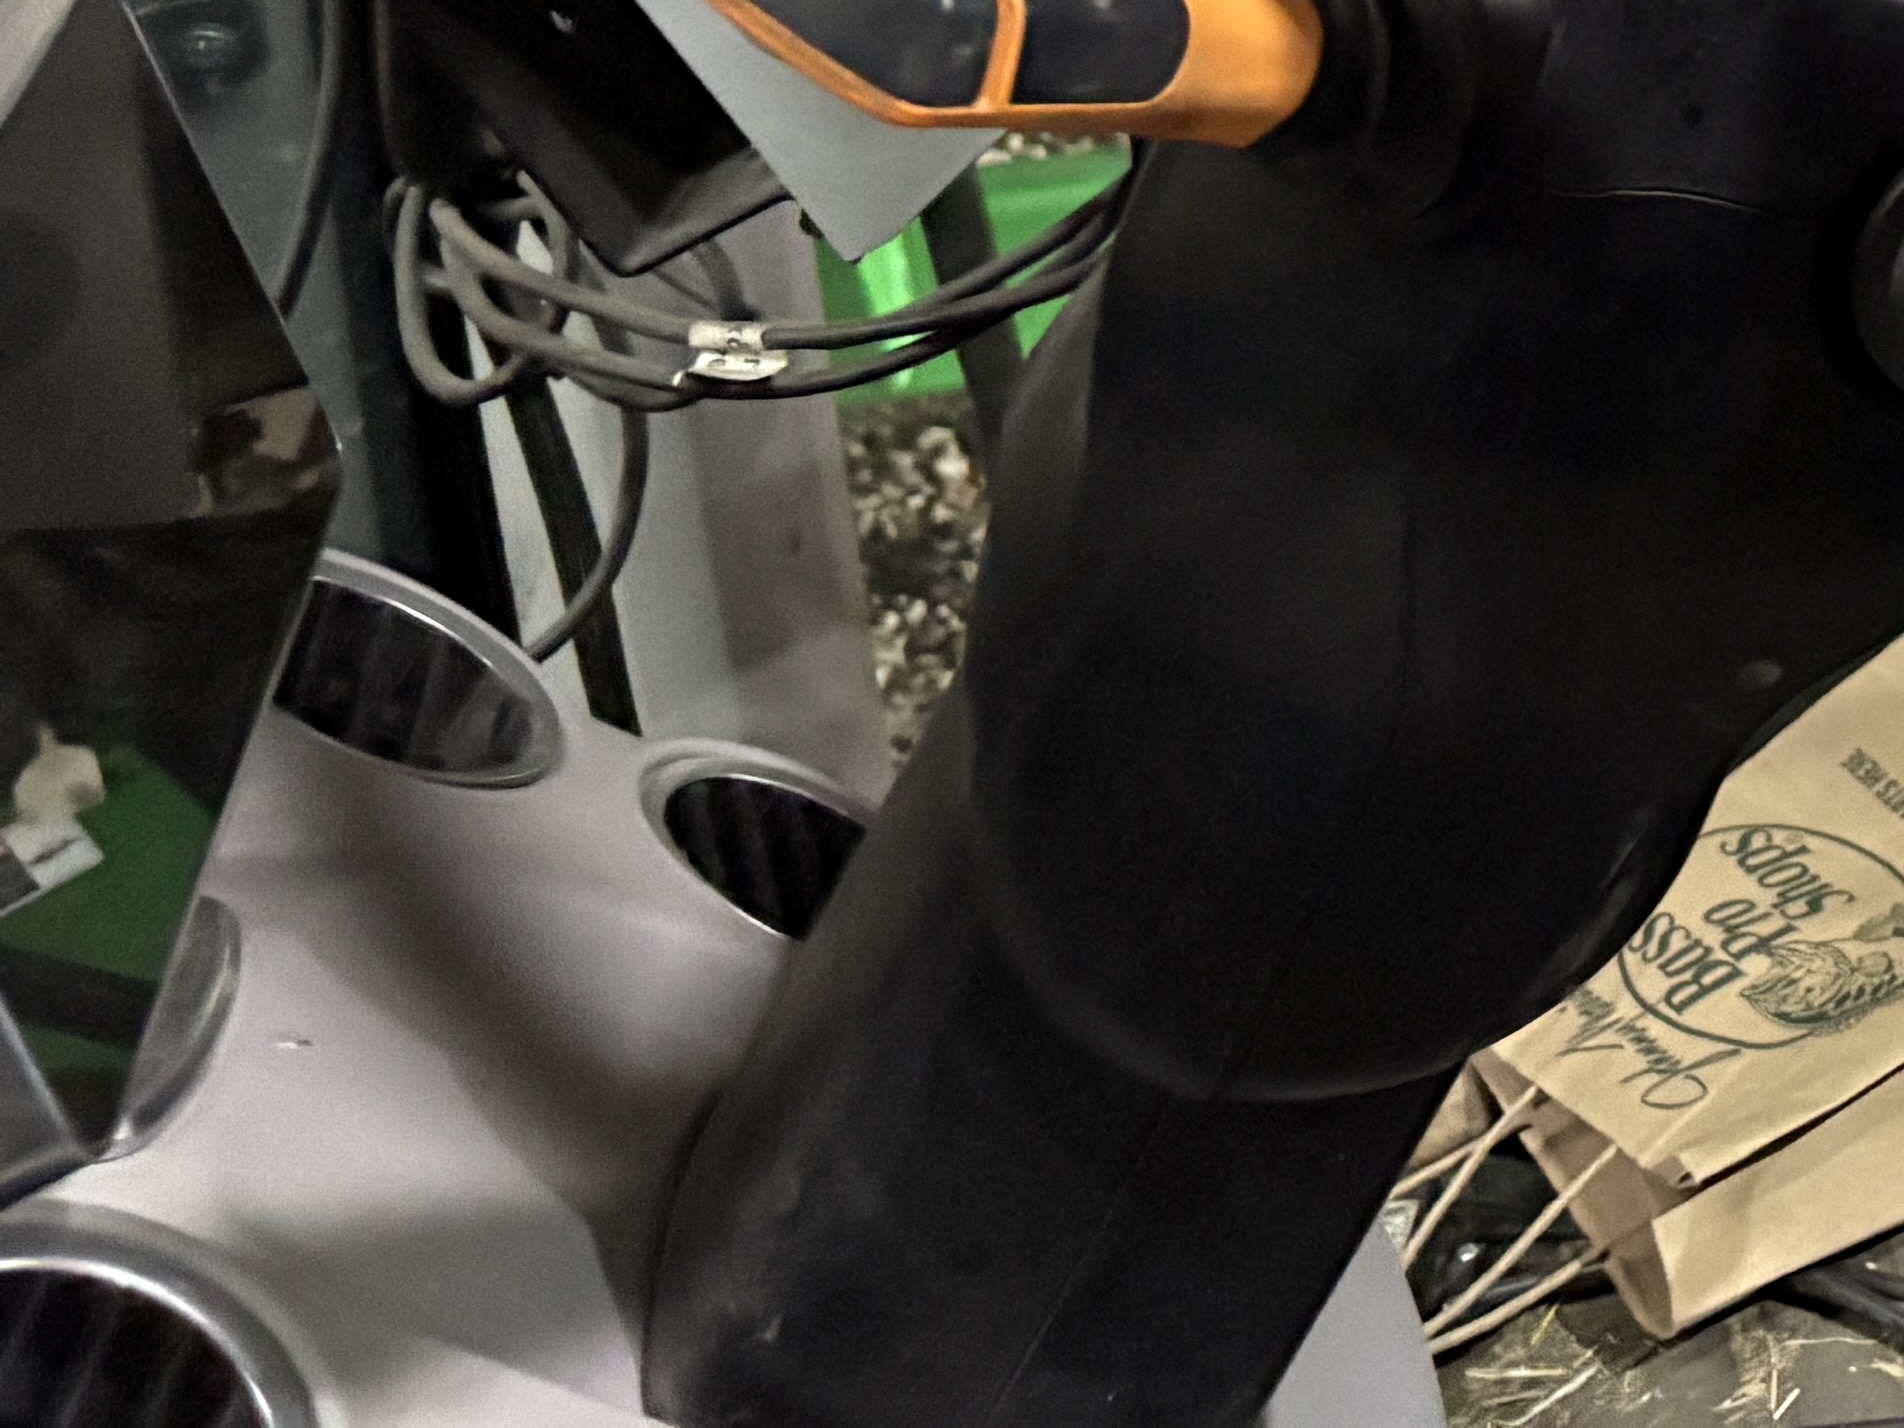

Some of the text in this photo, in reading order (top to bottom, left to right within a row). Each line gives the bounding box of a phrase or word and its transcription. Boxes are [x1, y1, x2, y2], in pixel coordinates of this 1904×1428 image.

[1718, 827, 1855, 919] Shops
[1625, 908, 1746, 1016] Bass
[1701, 900, 1798, 964] Pro
